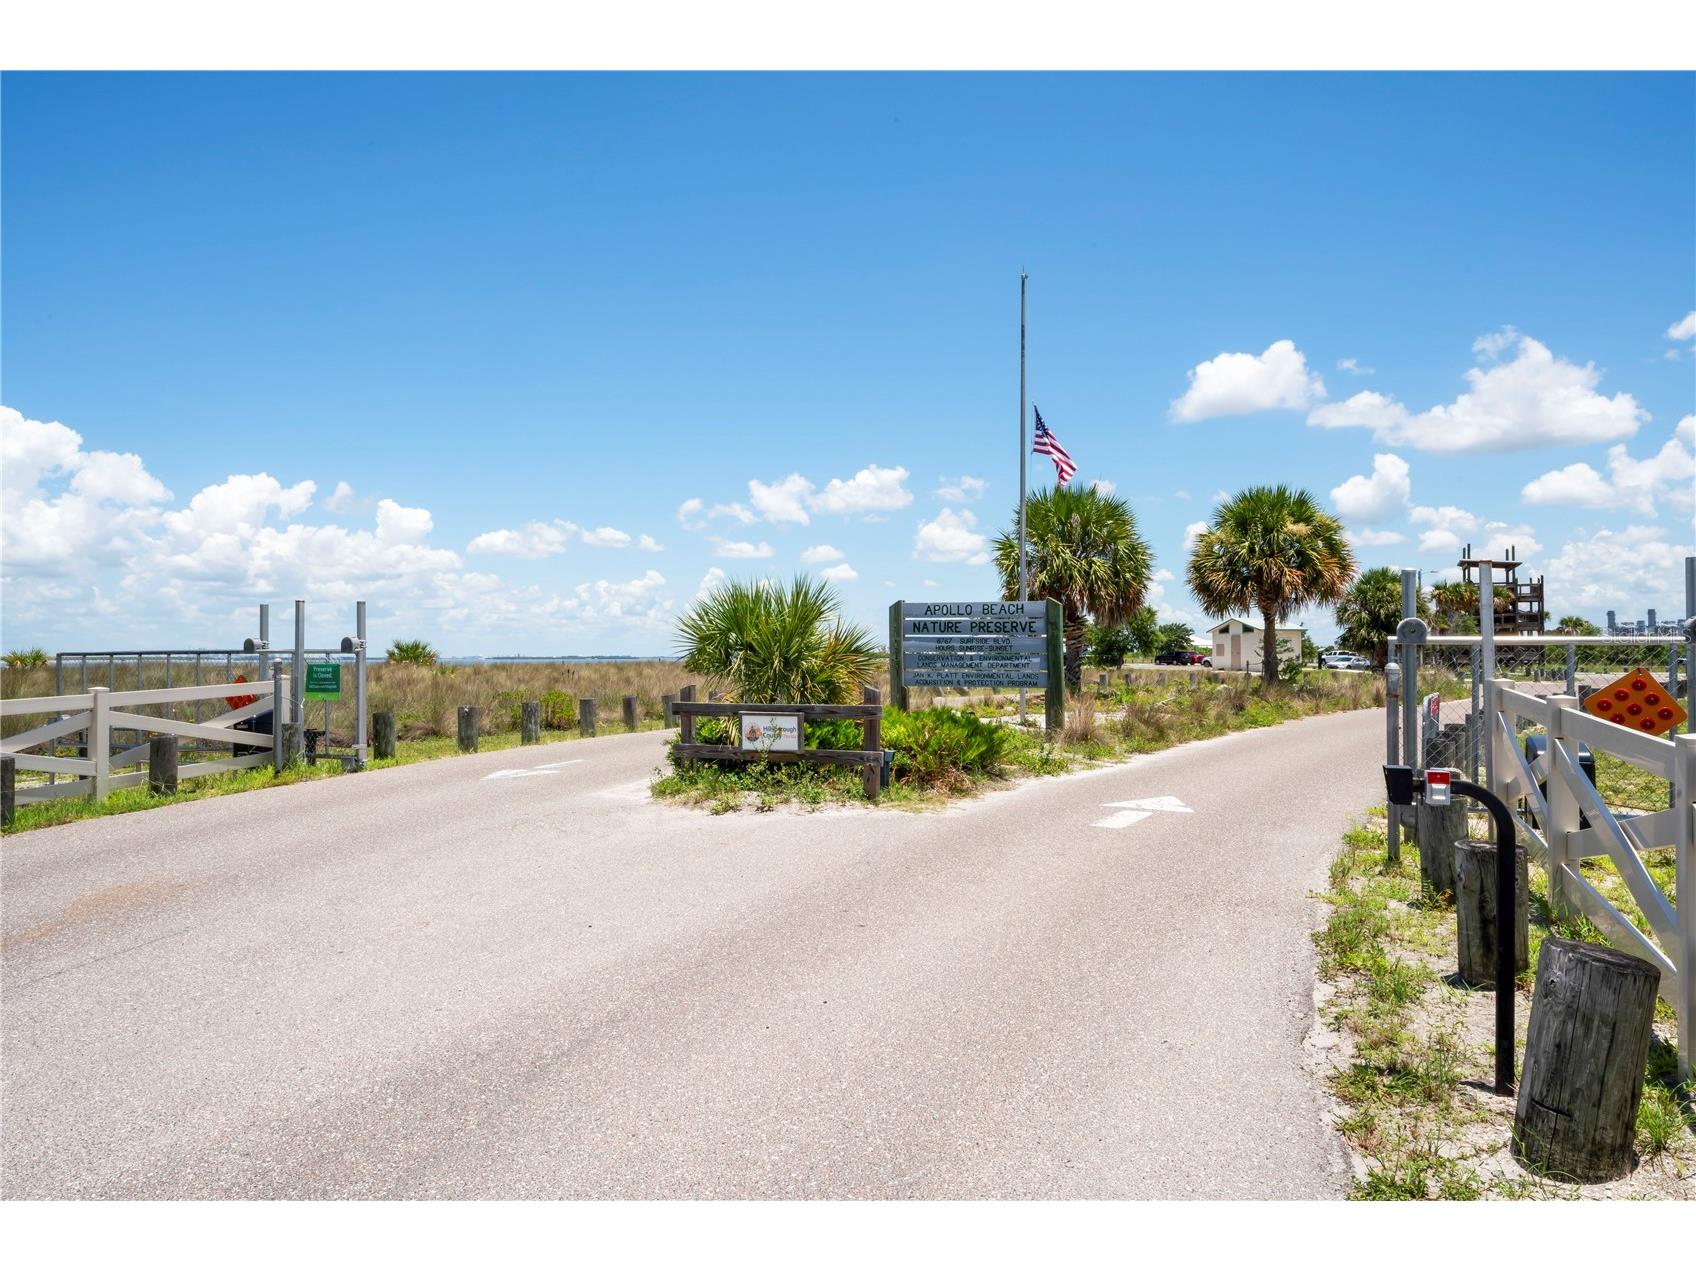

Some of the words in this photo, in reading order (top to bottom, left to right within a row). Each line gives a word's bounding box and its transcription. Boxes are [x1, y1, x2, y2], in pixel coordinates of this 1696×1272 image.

[925, 604, 972, 615] APOLLO
[983, 603, 1024, 615] BEACH
[913, 622, 962, 633] NATURE
[970, 621, 1036, 633] PRESERVE
